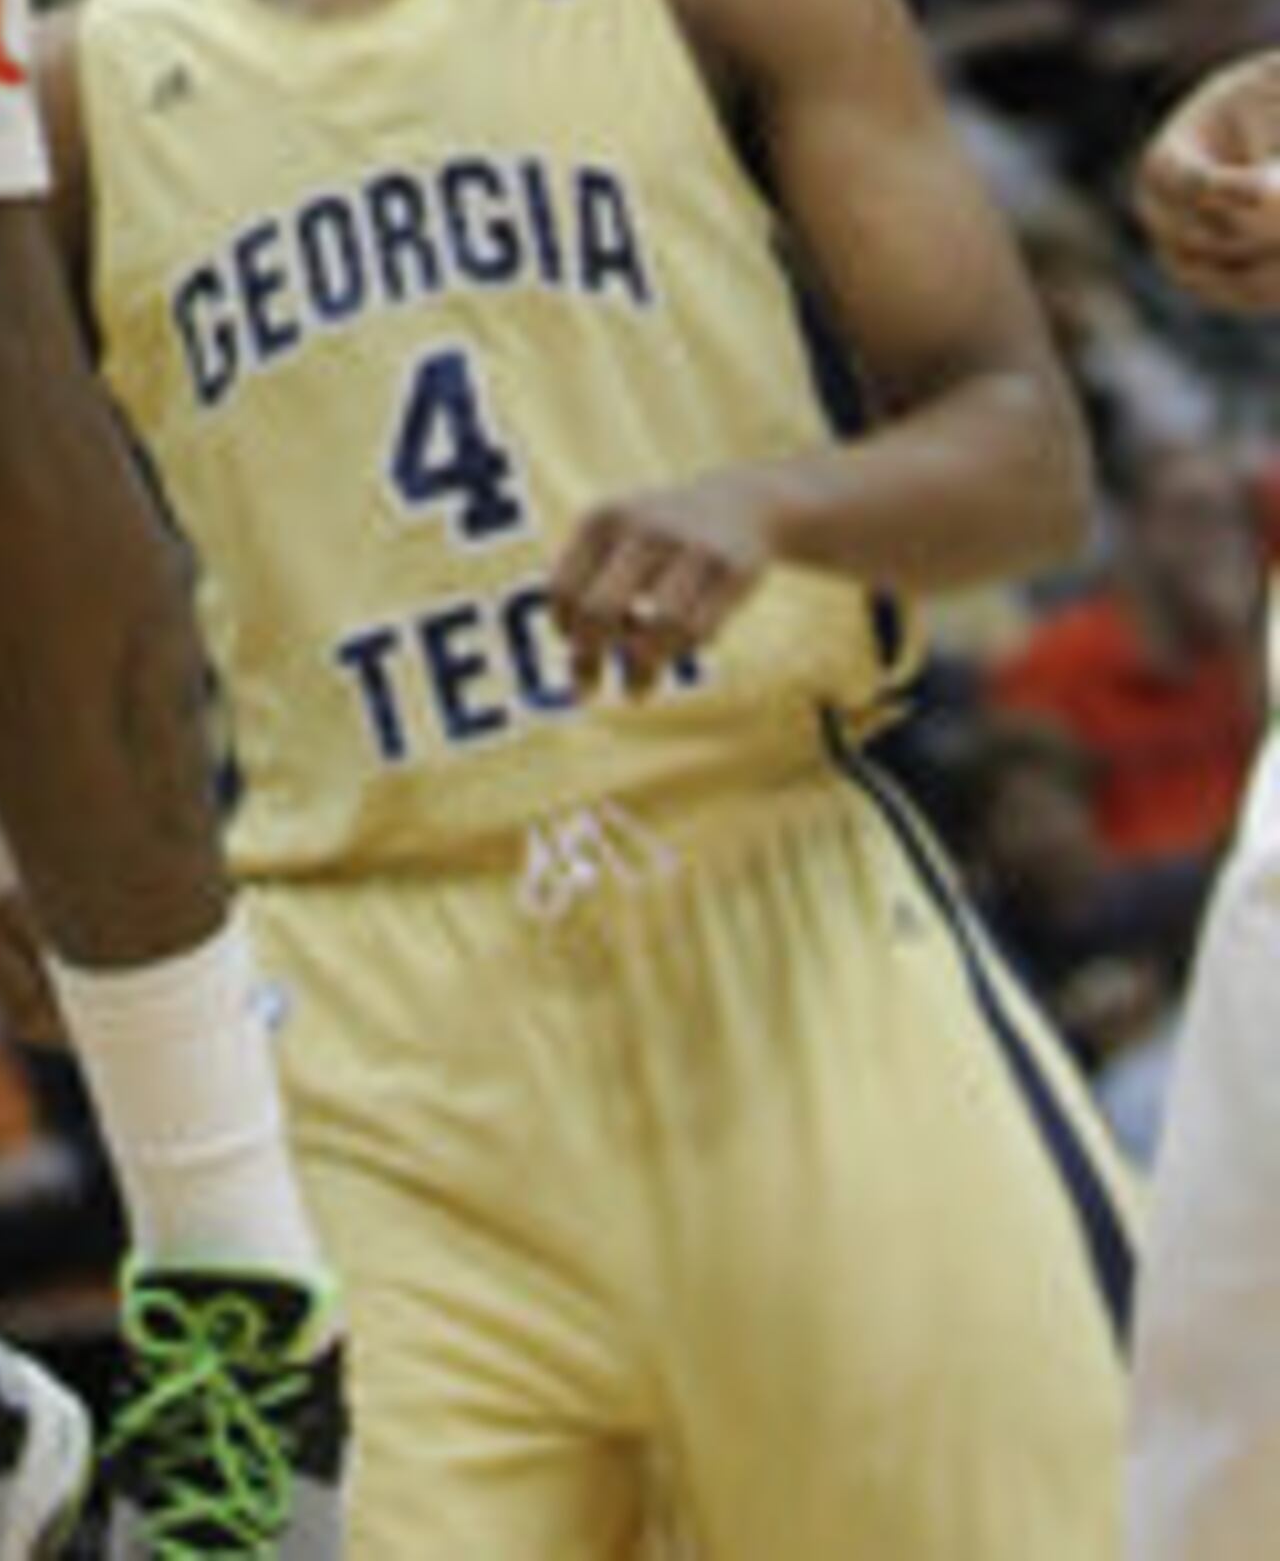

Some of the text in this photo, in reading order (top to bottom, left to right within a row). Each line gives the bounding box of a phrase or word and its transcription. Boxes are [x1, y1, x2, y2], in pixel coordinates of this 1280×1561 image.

[170, 156, 654, 408] GEORGIA
[388, 348, 522, 540] 4
[335, 588, 702, 764] TEC
